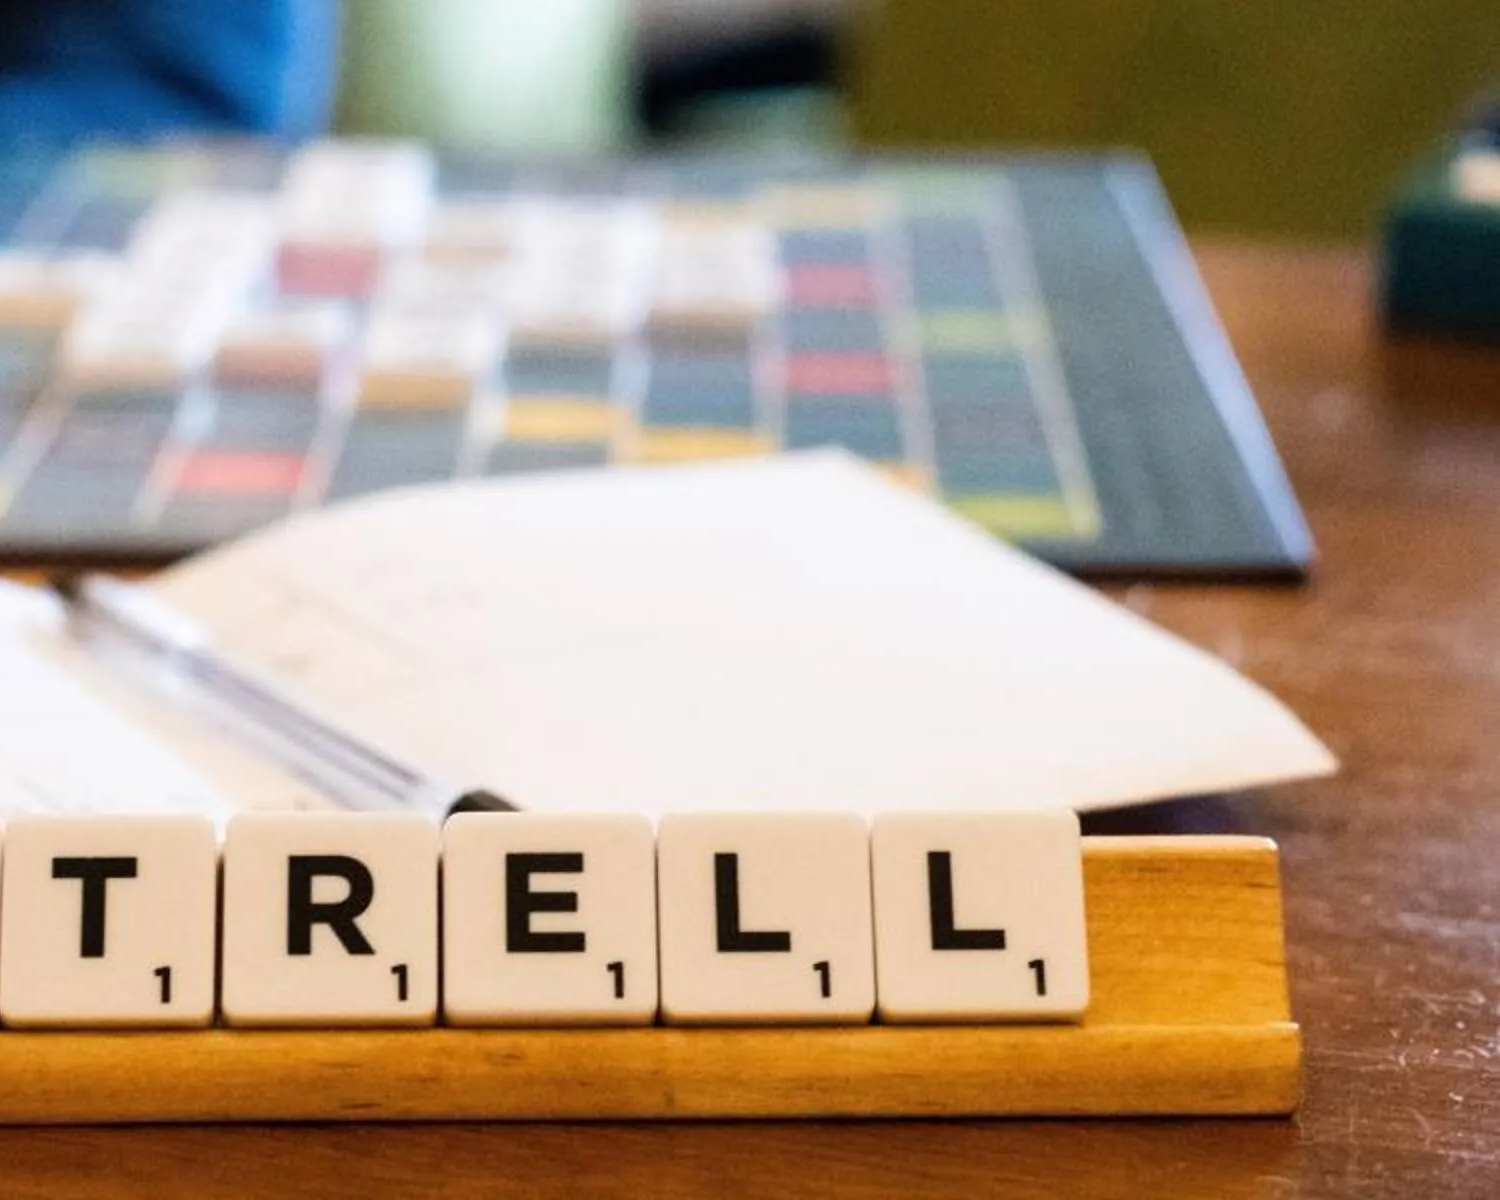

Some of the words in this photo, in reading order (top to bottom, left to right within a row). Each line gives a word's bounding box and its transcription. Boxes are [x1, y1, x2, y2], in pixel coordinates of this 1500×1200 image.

[154, 966, 171, 1004] 1
[391, 963, 408, 1002] 1
[606, 961, 625, 999] 1
[813, 961, 831, 998] 1
[1027, 959, 1046, 996] 1
